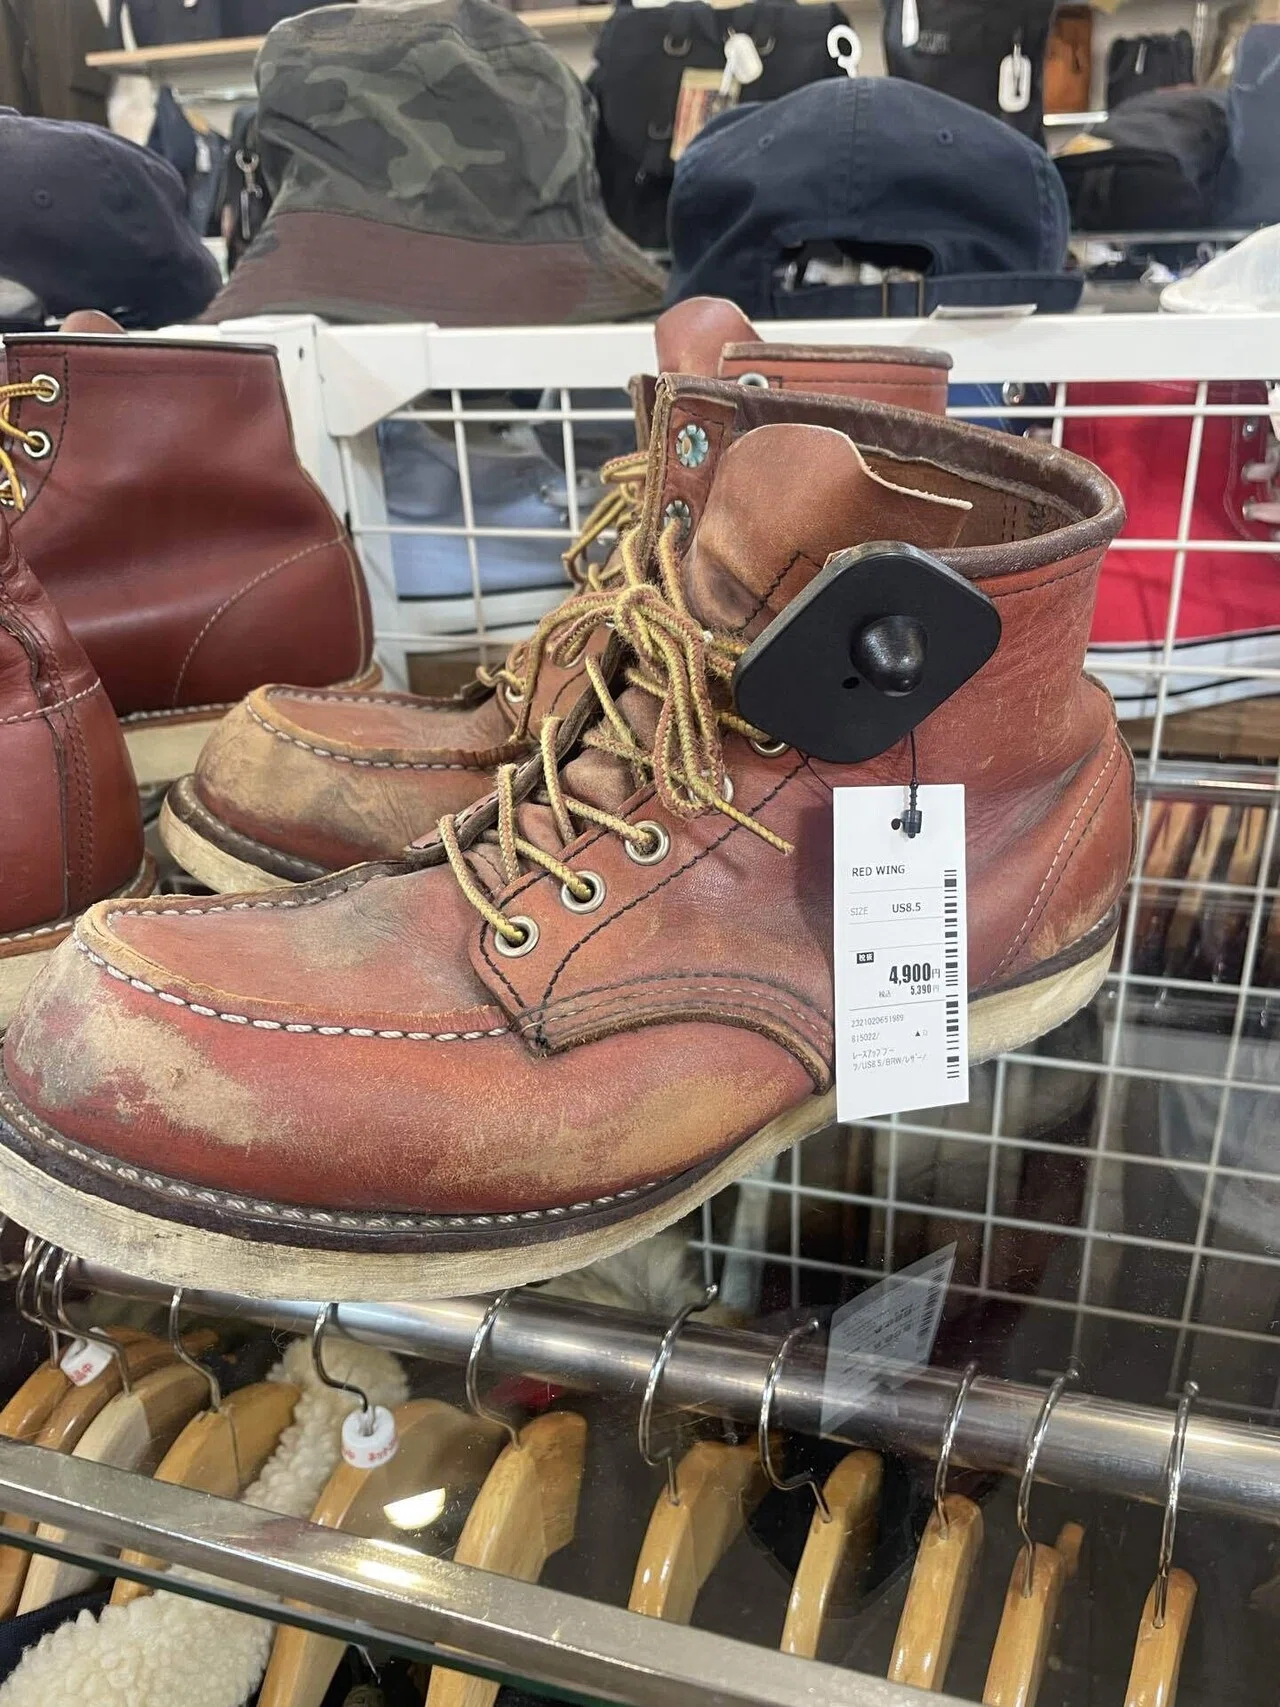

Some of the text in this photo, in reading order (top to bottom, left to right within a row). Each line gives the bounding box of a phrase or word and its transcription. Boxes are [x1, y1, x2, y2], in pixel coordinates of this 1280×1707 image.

[852, 864, 906, 877] RED WING
[850, 906, 869, 916] SIZE
[892, 902, 922, 913] US8.5
